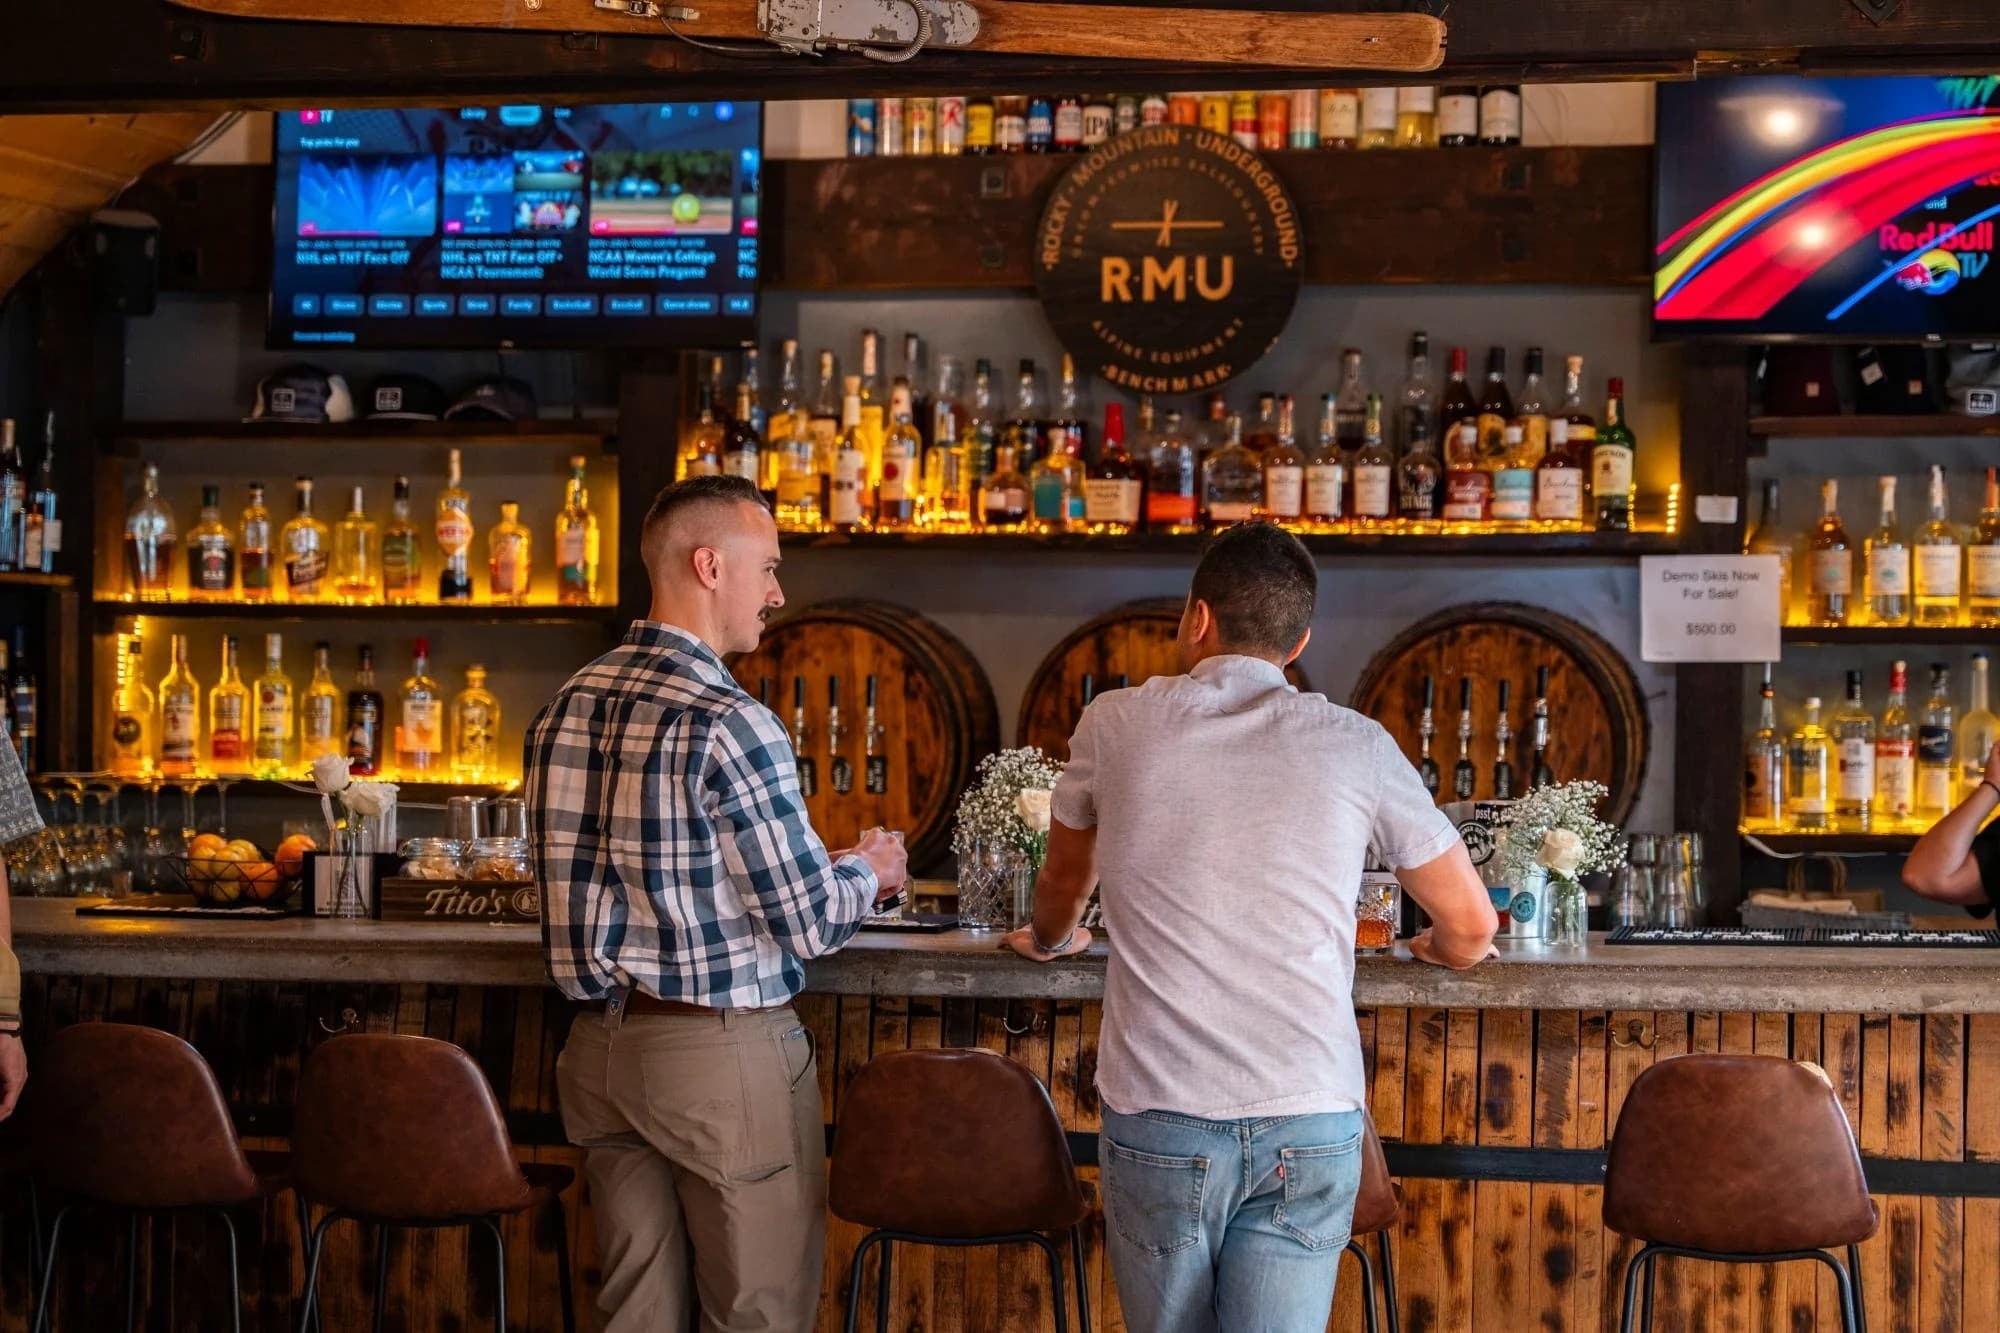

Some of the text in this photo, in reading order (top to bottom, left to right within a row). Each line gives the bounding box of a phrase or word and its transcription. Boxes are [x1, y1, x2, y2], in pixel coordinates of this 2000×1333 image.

[1072, 126, 1180, 188] MOUNTAIN
[1196, 127, 1298, 261] UNDERGROUND
[1881, 221, 1993, 251] Red Bull
[1956, 252, 1989, 278] TV
[1105, 363, 1230, 393] BENCHMARK
[1663, 569, 1760, 583] Demo Skis Now
[1683, 587, 1739, 600] For Sale!
[1686, 622, 1737, 636] $500.00
[424, 885, 506, 916] Tito's
